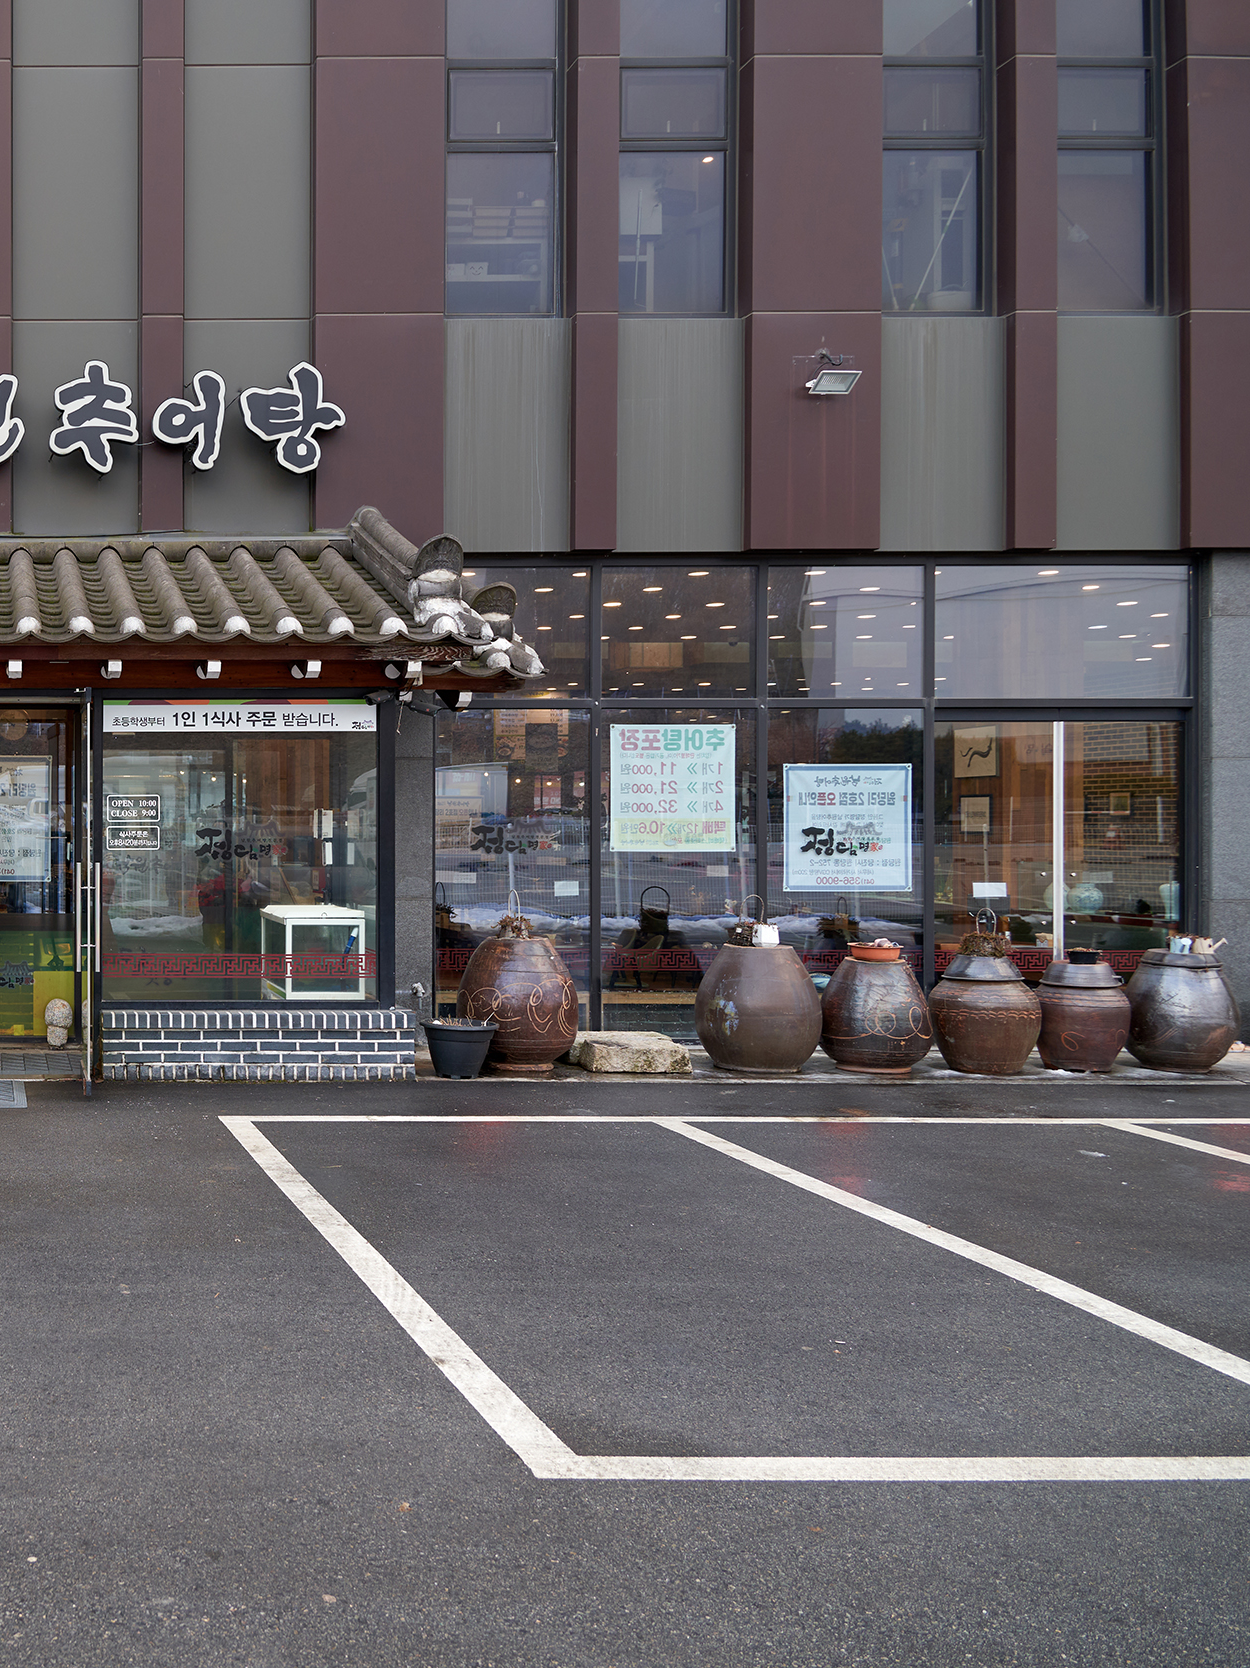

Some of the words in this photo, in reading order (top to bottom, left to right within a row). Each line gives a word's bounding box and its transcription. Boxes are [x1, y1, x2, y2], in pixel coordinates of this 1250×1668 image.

[112, 717, 165, 727] 초등학생부터
[172, 711, 196, 727] 1인
[202, 711, 242, 727] 1식사
[246, 711, 277, 727] 주문
[282, 712, 339, 727] 받습니다.
[110, 809, 138, 817] CLOSE
[141, 809, 156, 817] 9:00
